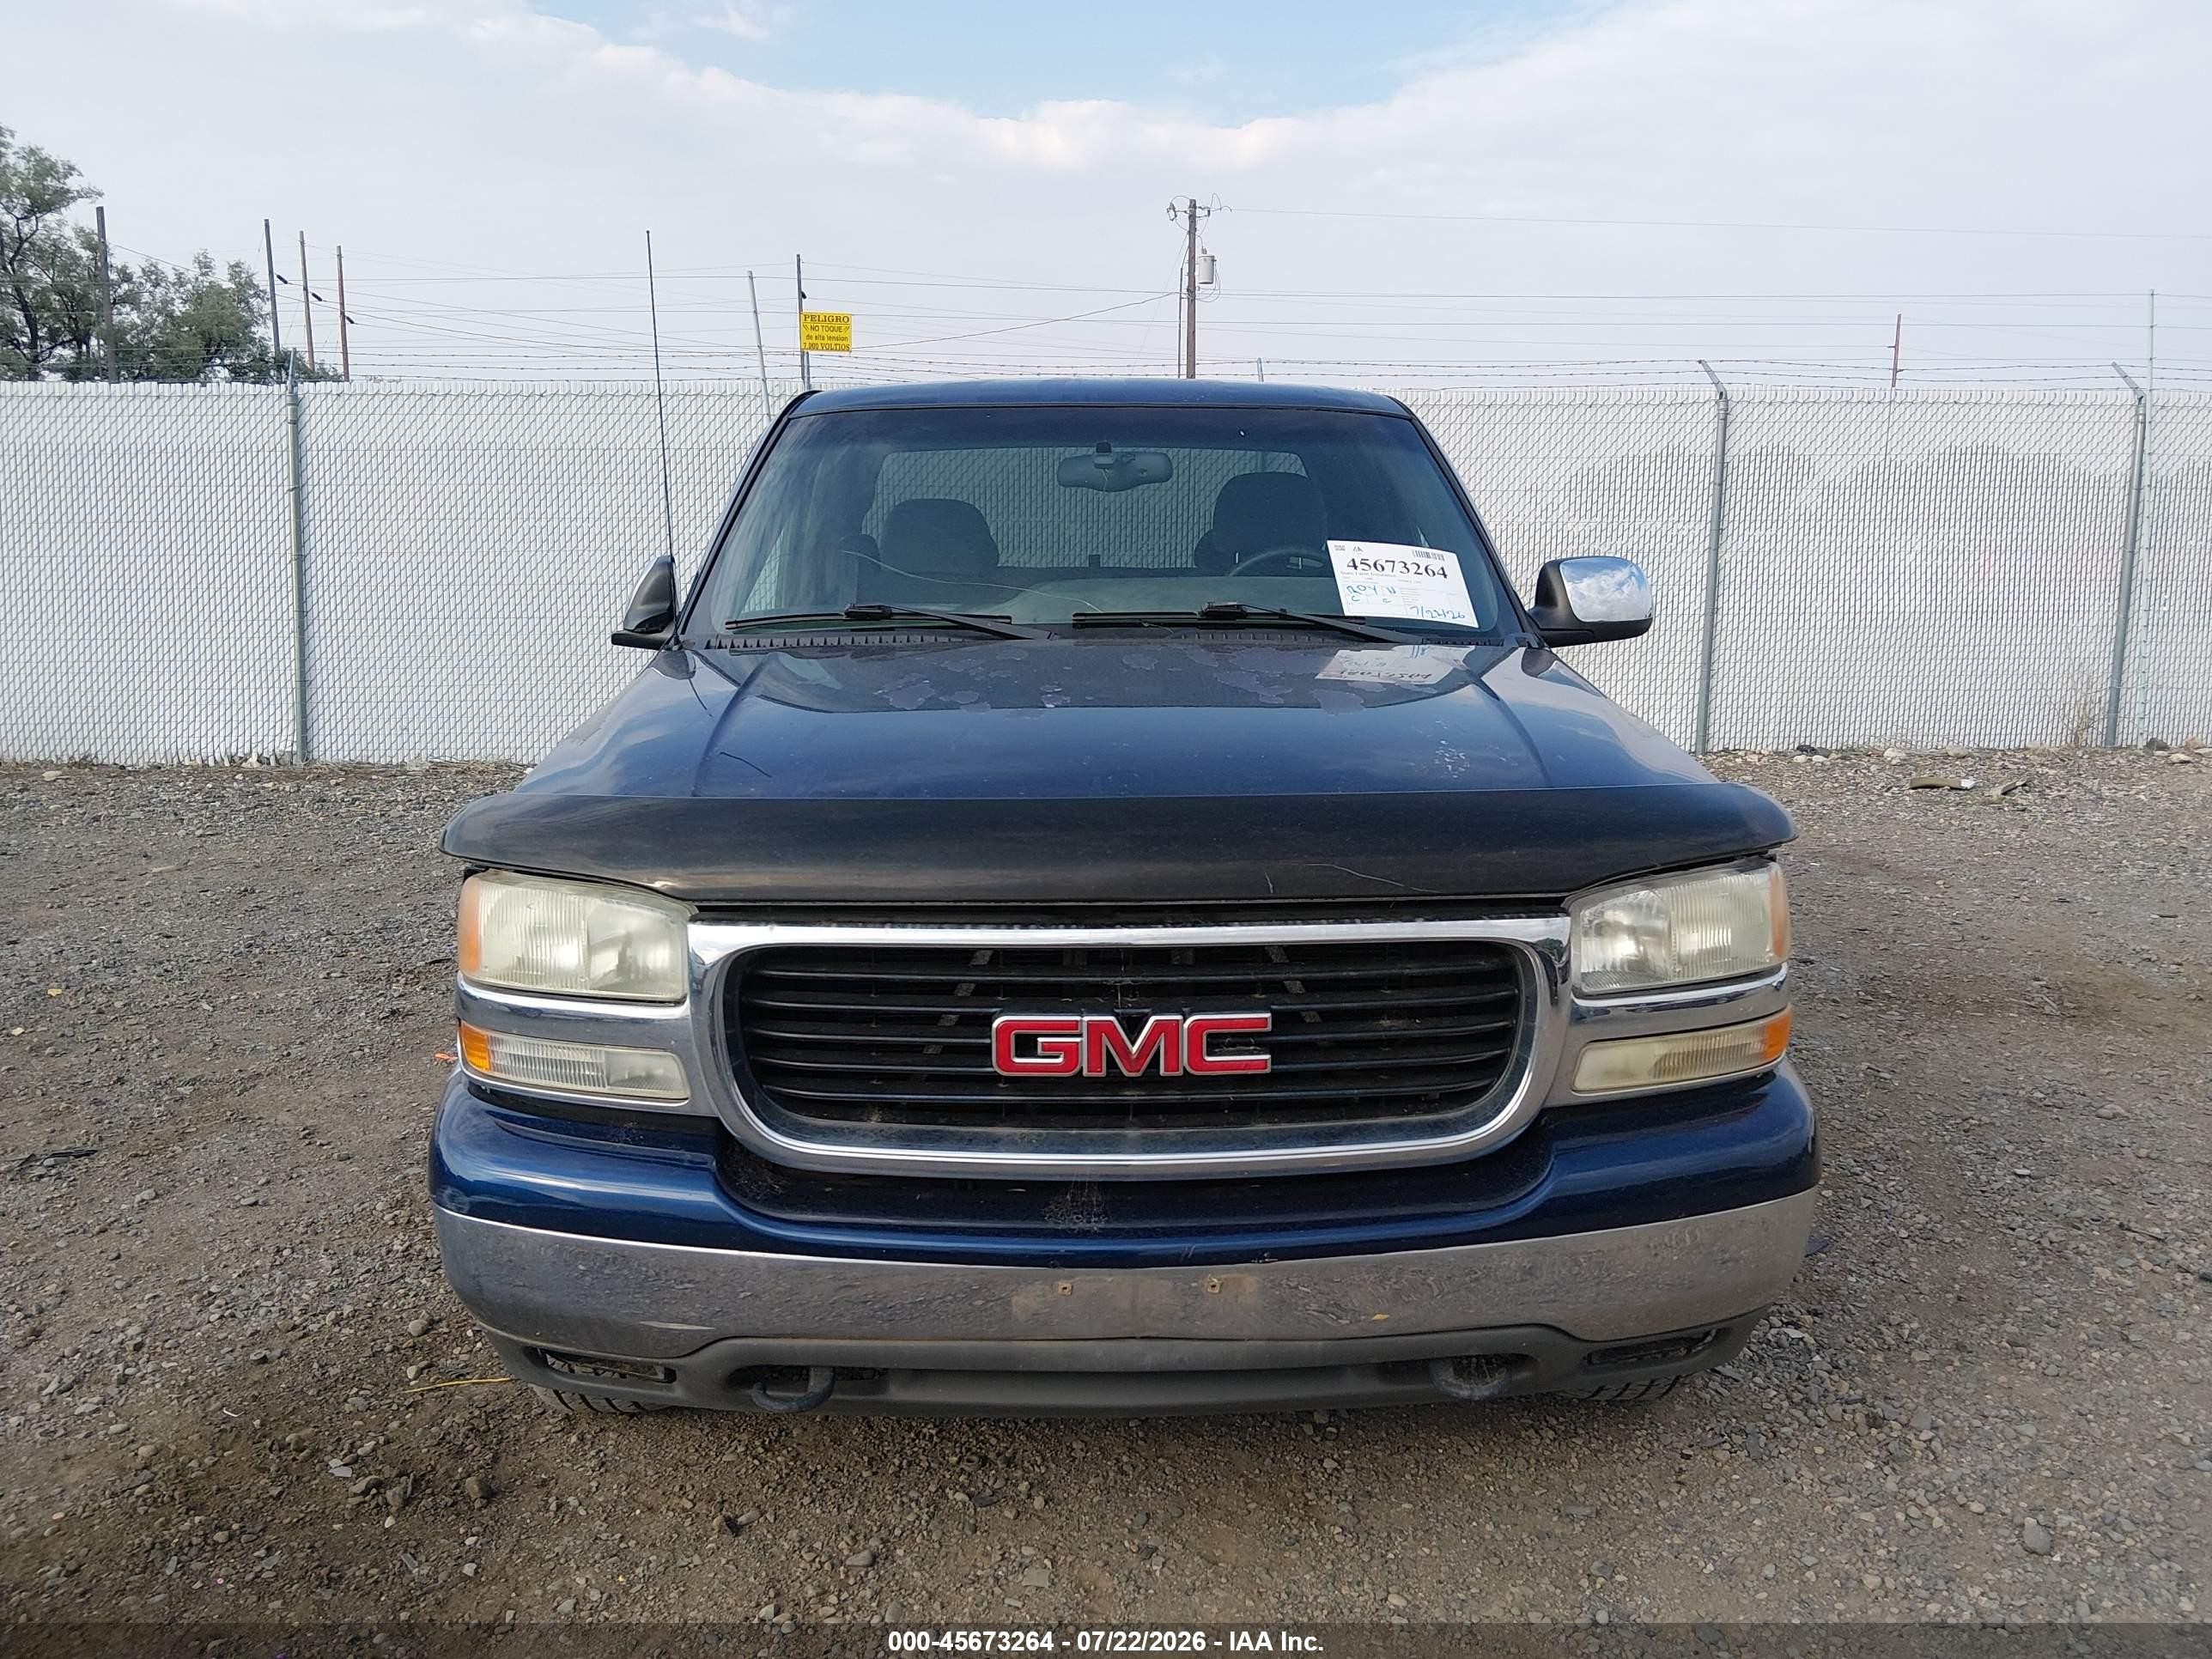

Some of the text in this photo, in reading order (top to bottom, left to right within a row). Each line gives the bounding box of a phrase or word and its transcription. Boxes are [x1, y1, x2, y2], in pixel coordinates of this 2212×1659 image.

[804, 314, 849, 323] PELIGRO
[1346, 557, 1448, 580] 45673264
[992, 1012, 1272, 1076] GMC
